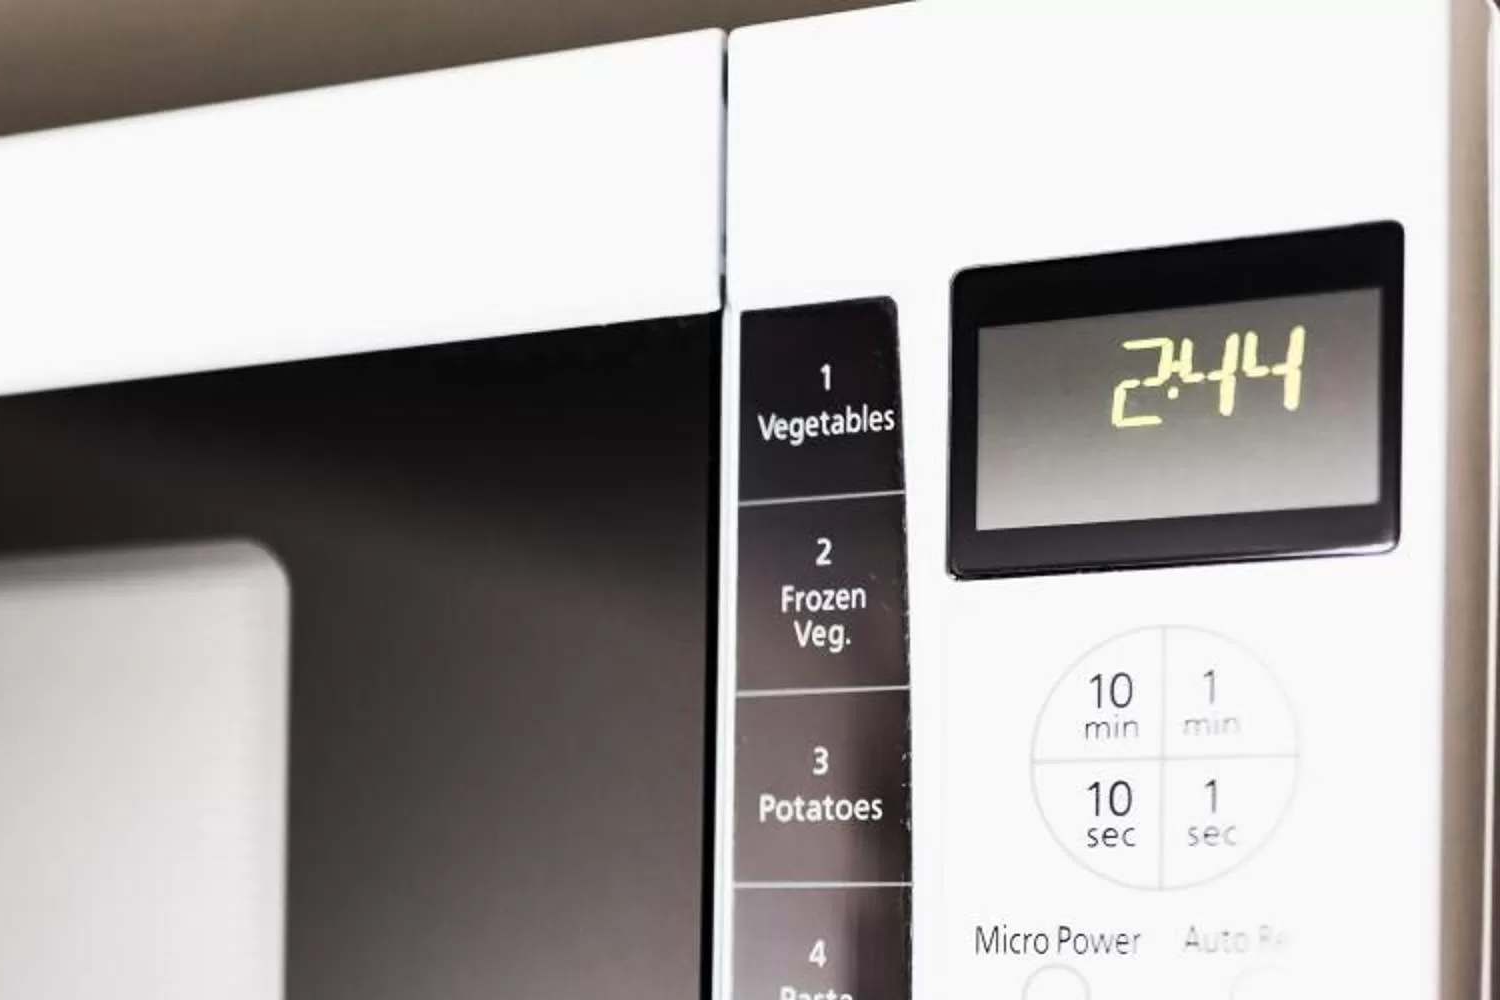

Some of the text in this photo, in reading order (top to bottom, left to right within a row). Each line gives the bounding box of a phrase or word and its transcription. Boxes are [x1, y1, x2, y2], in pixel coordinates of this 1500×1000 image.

[820, 364, 832, 391] 1
[1111, 325, 1305, 428] 2:44
[757, 404, 895, 446] Vegetables
[816, 538, 832, 566] 2
[781, 583, 867, 613] Frozen
[794, 620, 851, 653] Veg.
[1089, 671, 1133, 709] 10
[1203, 668, 1216, 704] 1
[1084, 714, 1140, 740] min
[1183, 715, 1242, 736] min
[813, 746, 829, 775] 3
[759, 793, 883, 824] Potatoes
[1086, 780, 1133, 817] 10
[1203, 779, 1218, 814] 1
[1087, 826, 1137, 848] sec
[1187, 825, 1238, 847] sec
[808, 939, 828, 968] 4
[974, 924, 1142, 956] Micro Power
[1182, 925, 1250, 954] Auto
